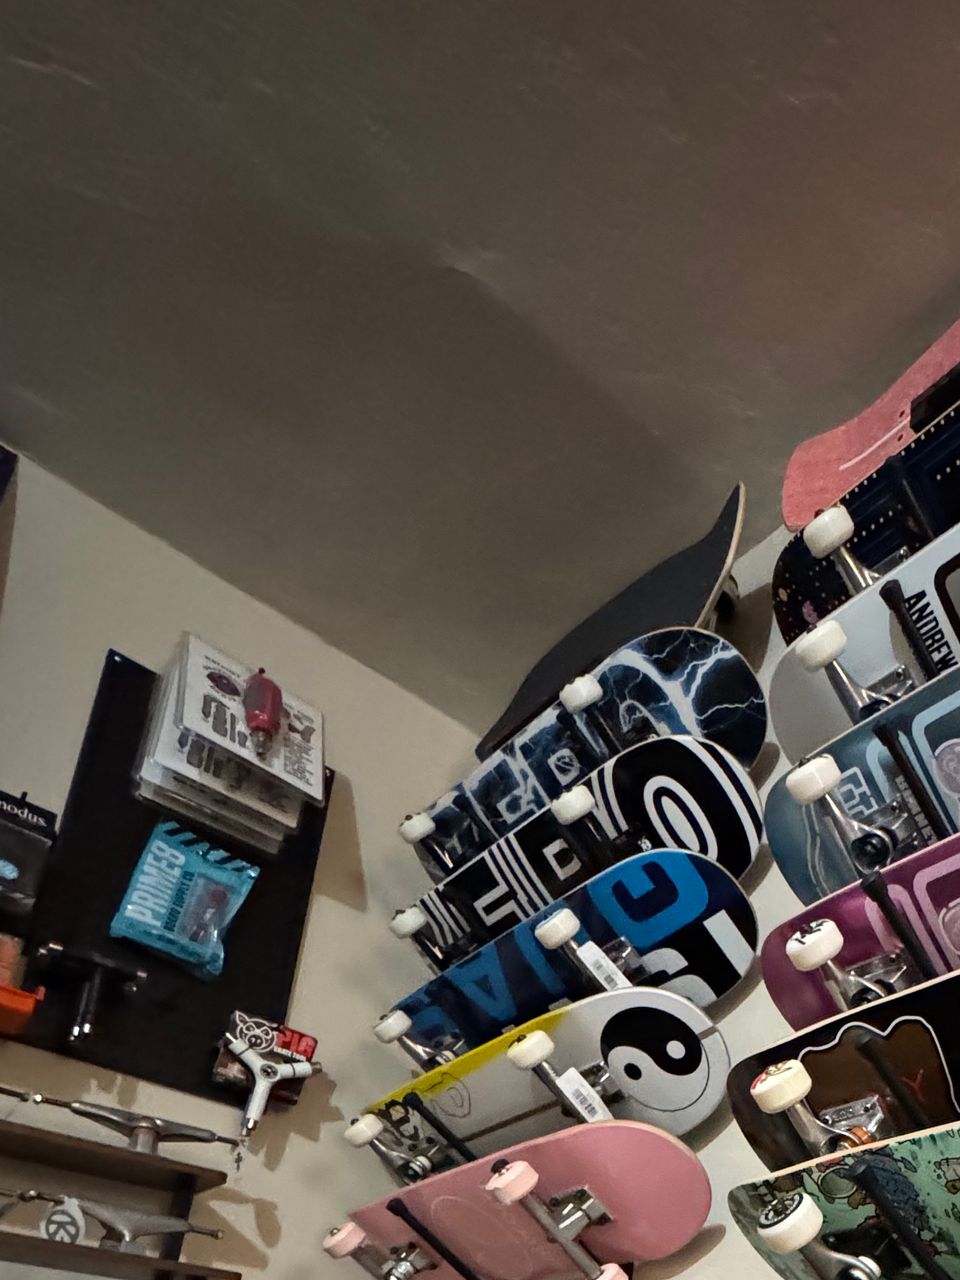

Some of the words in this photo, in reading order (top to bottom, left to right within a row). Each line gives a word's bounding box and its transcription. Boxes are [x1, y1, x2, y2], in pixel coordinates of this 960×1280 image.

[905, 589, 960, 672] ANDREW
[124, 839, 186, 927] PRIME8
[275, 1029, 315, 1058] PIG
